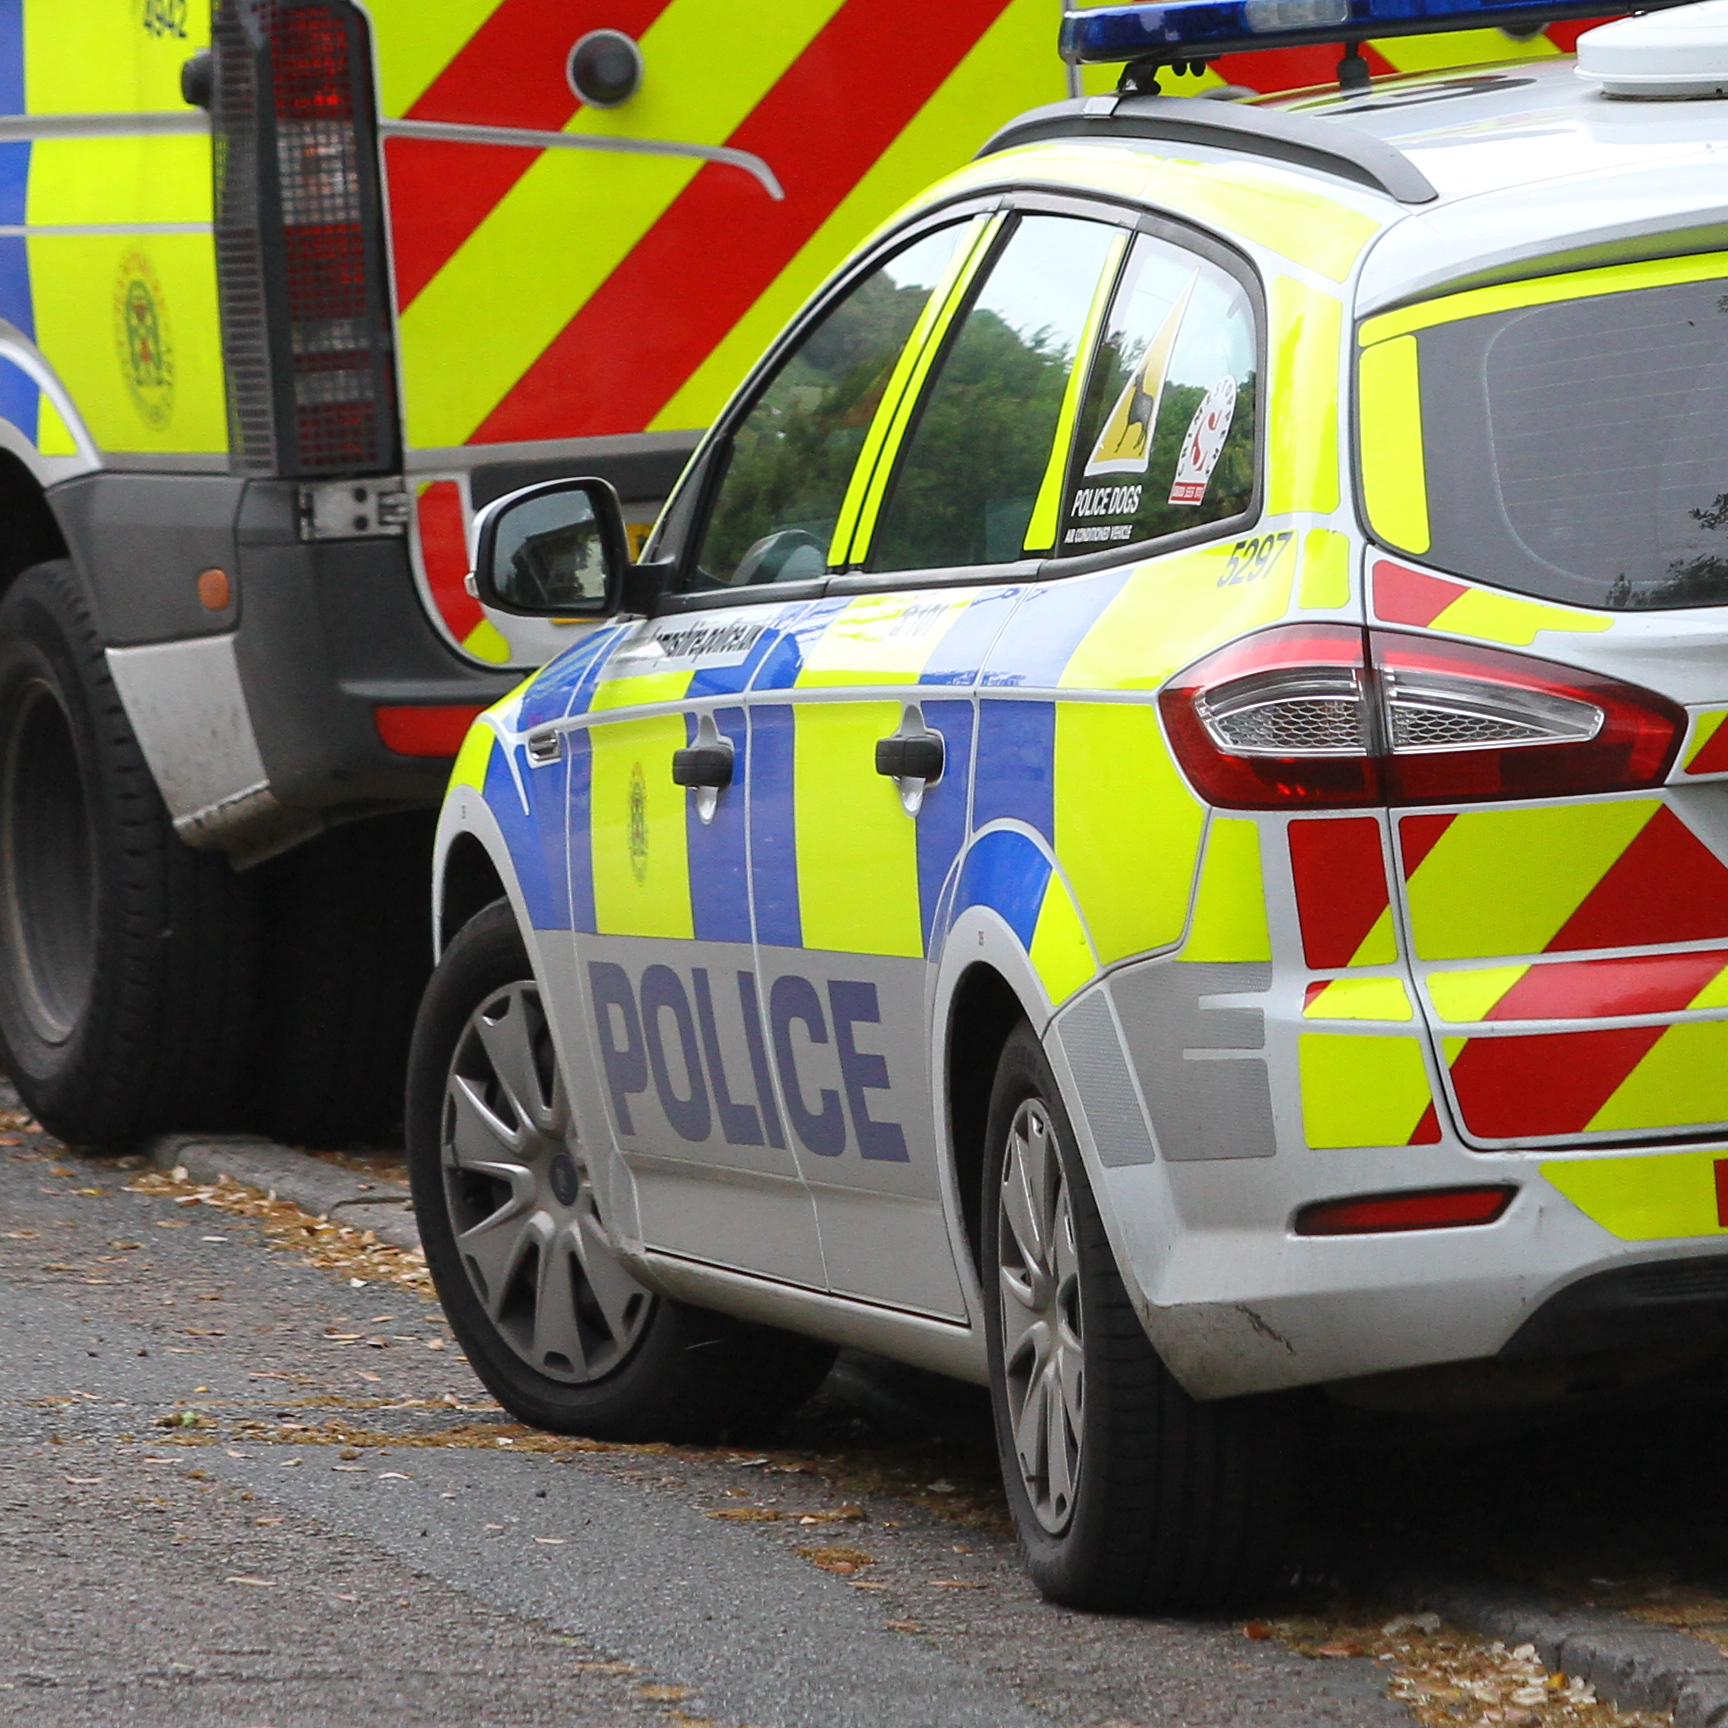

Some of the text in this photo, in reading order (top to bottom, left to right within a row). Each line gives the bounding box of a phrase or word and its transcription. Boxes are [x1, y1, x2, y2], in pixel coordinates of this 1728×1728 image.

[1070, 487, 1113, 518] POLICE
[1108, 484, 1143, 515] DOGS
[1216, 530, 1294, 588] 5297
[587, 960, 911, 1164] POLICE
